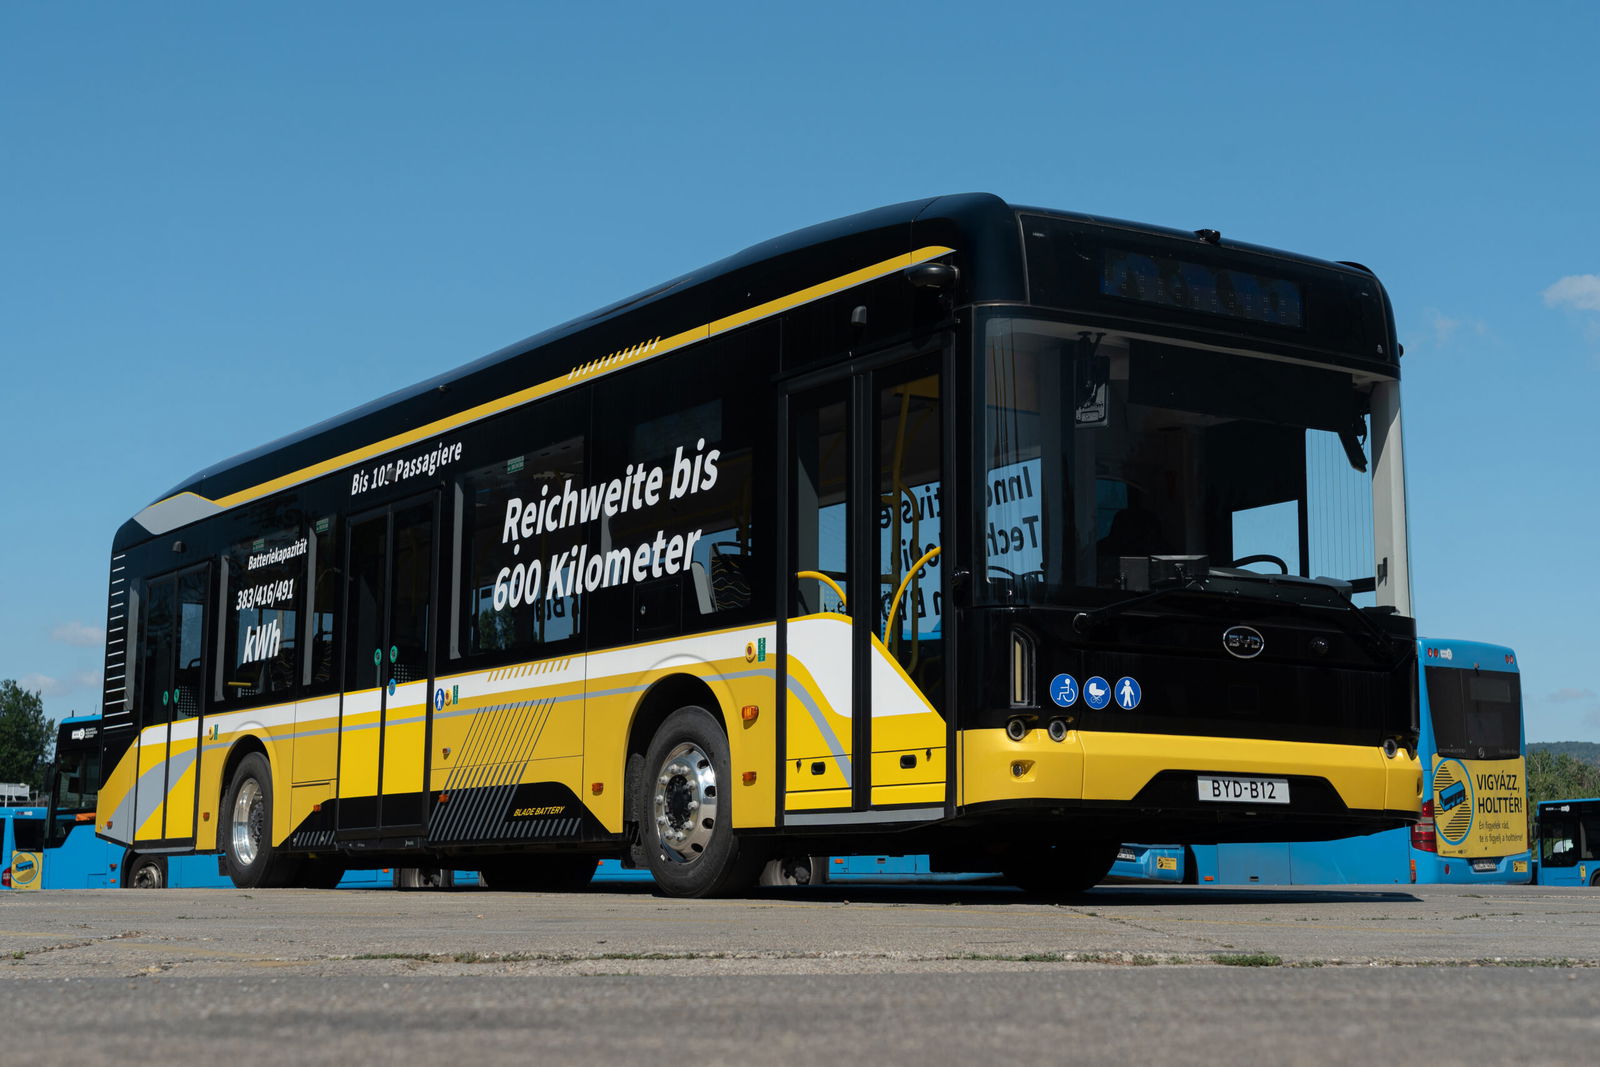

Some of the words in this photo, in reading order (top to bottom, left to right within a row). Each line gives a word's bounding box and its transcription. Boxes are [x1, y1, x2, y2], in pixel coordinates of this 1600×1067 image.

[351, 469, 369, 496] Bis
[395, 442, 463, 482] Passagiere
[502, 463, 664, 543] Reichweite
[669, 438, 721, 500] bis
[247, 538, 307, 570] Batteriekapazität
[493, 559, 542, 612] 600
[546, 529, 702, 601] Kilometer
[236, 578, 294, 611] 383/416/491
[243, 619, 281, 664] kWh
[1229, 634, 1261, 648] BYD
[1212, 780, 1276, 799] BYD-B12
[1476, 770, 1520, 792] VIGYÁZZ,
[513, 808, 536, 817] BLADE
[535, 806, 565, 815] BATTERY
[1478, 793, 1522, 813] HOLTTÉR!
